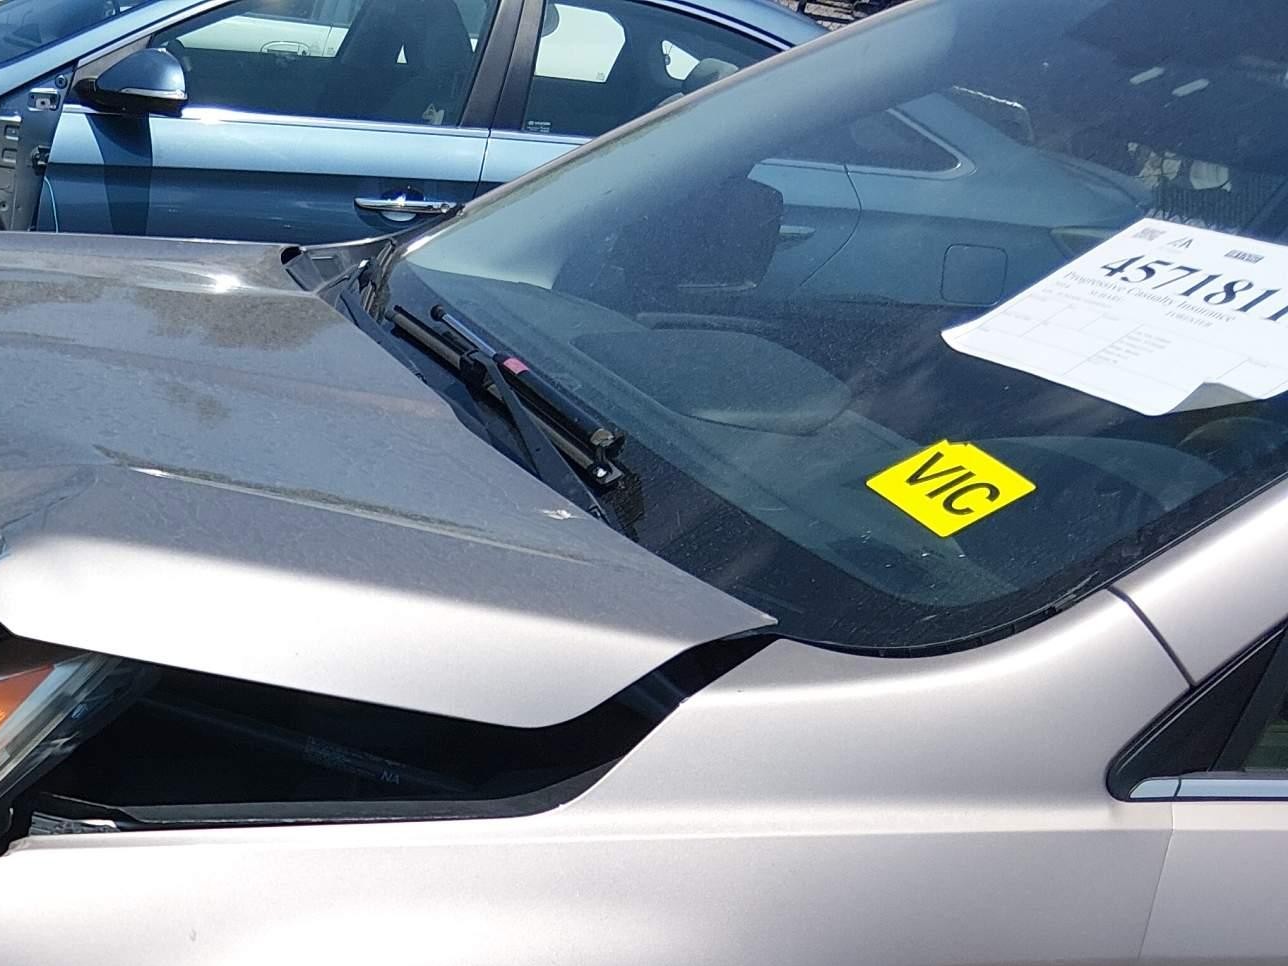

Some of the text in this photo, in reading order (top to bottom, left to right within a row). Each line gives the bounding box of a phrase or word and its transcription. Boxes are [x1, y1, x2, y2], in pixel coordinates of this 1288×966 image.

[1064, 271, 1127, 294] Progressive
[1127, 287, 1174, 305] Casualty
[1177, 301, 1236, 322] Insurance
[906, 451, 1001, 515] VIC
